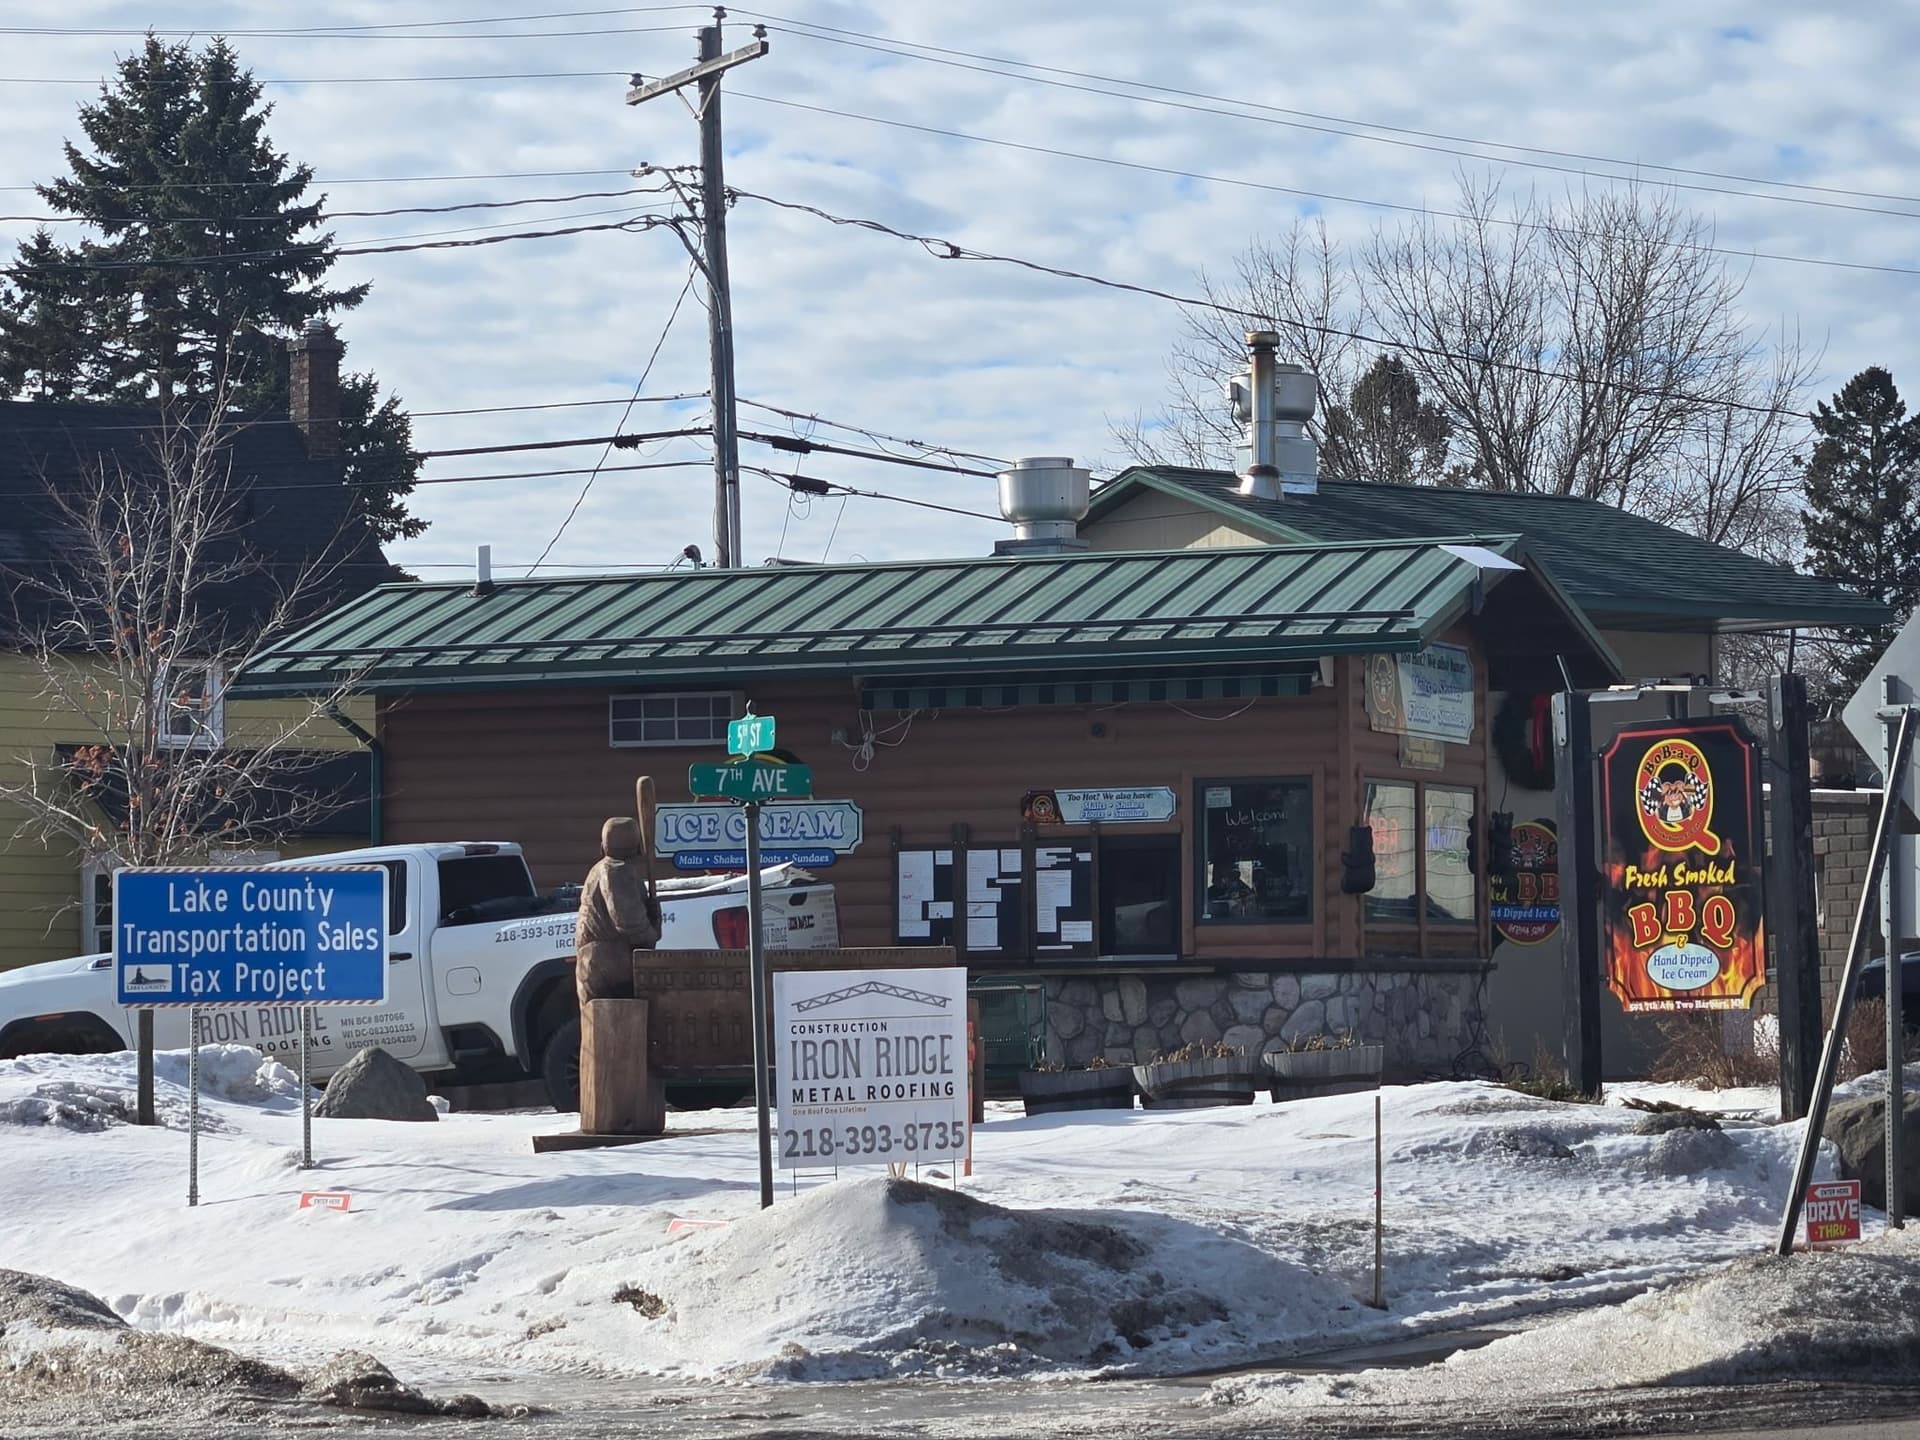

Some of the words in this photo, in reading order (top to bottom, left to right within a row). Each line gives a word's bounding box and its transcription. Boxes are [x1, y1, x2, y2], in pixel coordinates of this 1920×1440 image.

[750, 722, 761, 747] ST
[715, 769, 743, 792] 7TH
[751, 769, 788, 792] AVE
[664, 812, 719, 842] ICE
[725, 810, 844, 841] CREAM
[678, 855, 703, 866] Malts
[713, 854, 744, 866] Shakes
[760, 853, 781, 864] loats
[791, 852, 830, 864] Sundaes
[1517, 872, 1560, 901] BB
[1625, 865, 1668, 889] Fresh
[1673, 860, 1736, 887] Smoked
[169, 882, 229, 912] Lake
[242, 881, 335, 917] County
[1628, 890, 1736, 948] BBQ
[123, 922, 306, 958] Transportation
[317, 920, 379, 951] Sales
[495, 922, 577, 943] 218-393-8735
[1653, 955, 1677, 966] Hand
[1680, 953, 1713, 968] Dipped
[178, 963, 222, 994] Tax
[236, 961, 326, 999] Project
[1662, 968, 1675, 979] Ice
[1678, 968, 1708, 979] Cream
[1675, 1000, 1693, 1010] Two
[199, 1010, 250, 1044] RON
[258, 1006, 328, 1038] RIDE
[791, 1021, 888, 1035] CONSTRUCTION
[256, 1035, 331, 1053] ROOFNG
[791, 1037, 862, 1081] IRON
[875, 1034, 953, 1078] RIDGE
[792, 1085, 856, 1104] METAL
[867, 1081, 954, 1100] ROOFING
[784, 1120, 965, 1158] 218-393-8735
[1807, 1199, 1859, 1222] DRIVE
[1817, 1223, 1847, 1239] THRU
